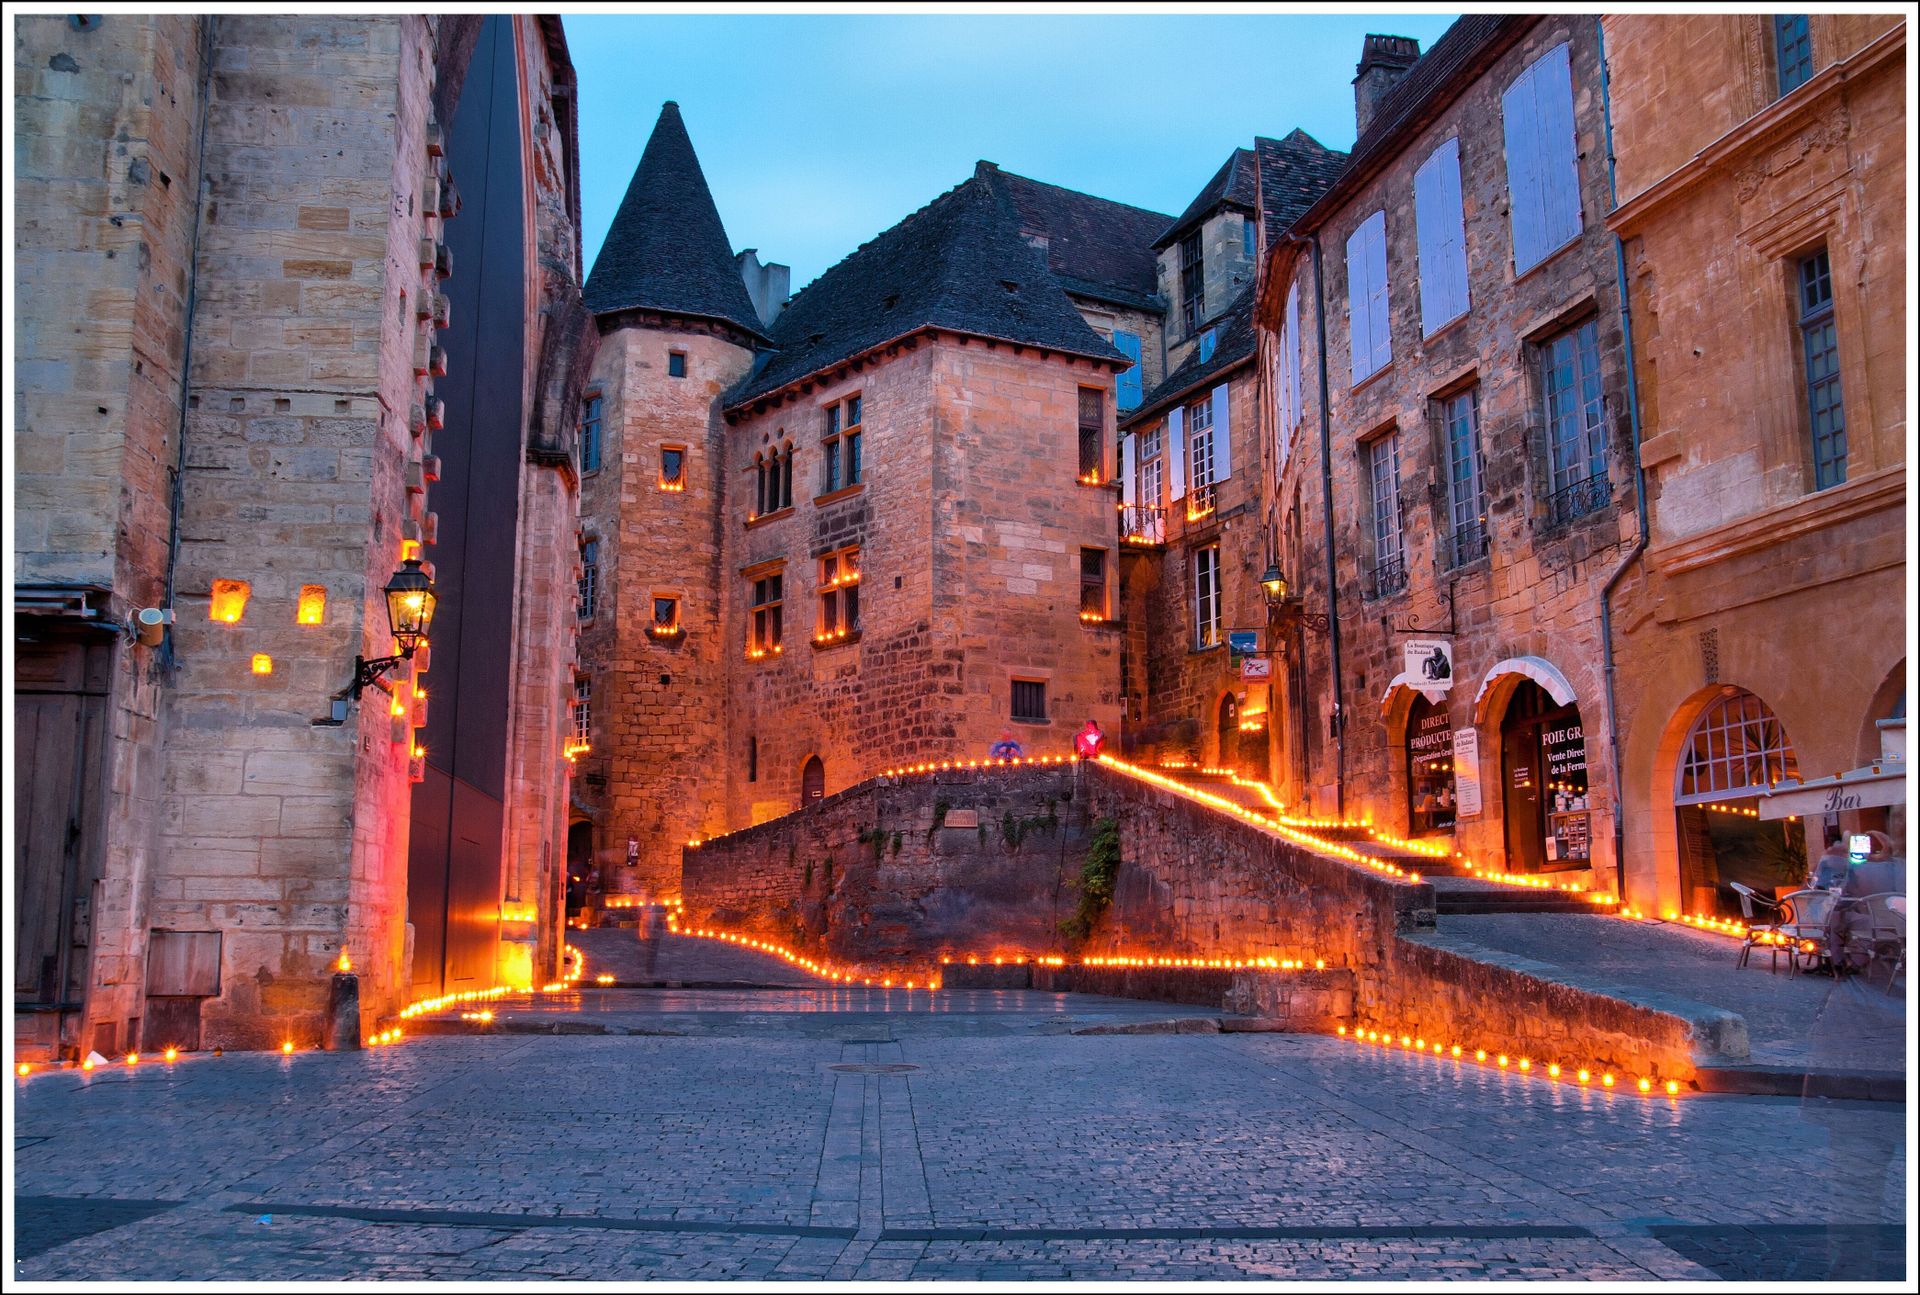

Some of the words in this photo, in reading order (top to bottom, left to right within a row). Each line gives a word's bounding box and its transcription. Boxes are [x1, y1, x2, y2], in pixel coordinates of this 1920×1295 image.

[1421, 713, 1449, 730] DIRECT
[1542, 729, 1566, 746] FOIE
[1547, 752, 1566, 762] Vente
[1551, 765, 1559, 775] de
[1560, 764, 1566, 773] la
[1825, 786, 1861, 811] Bar
